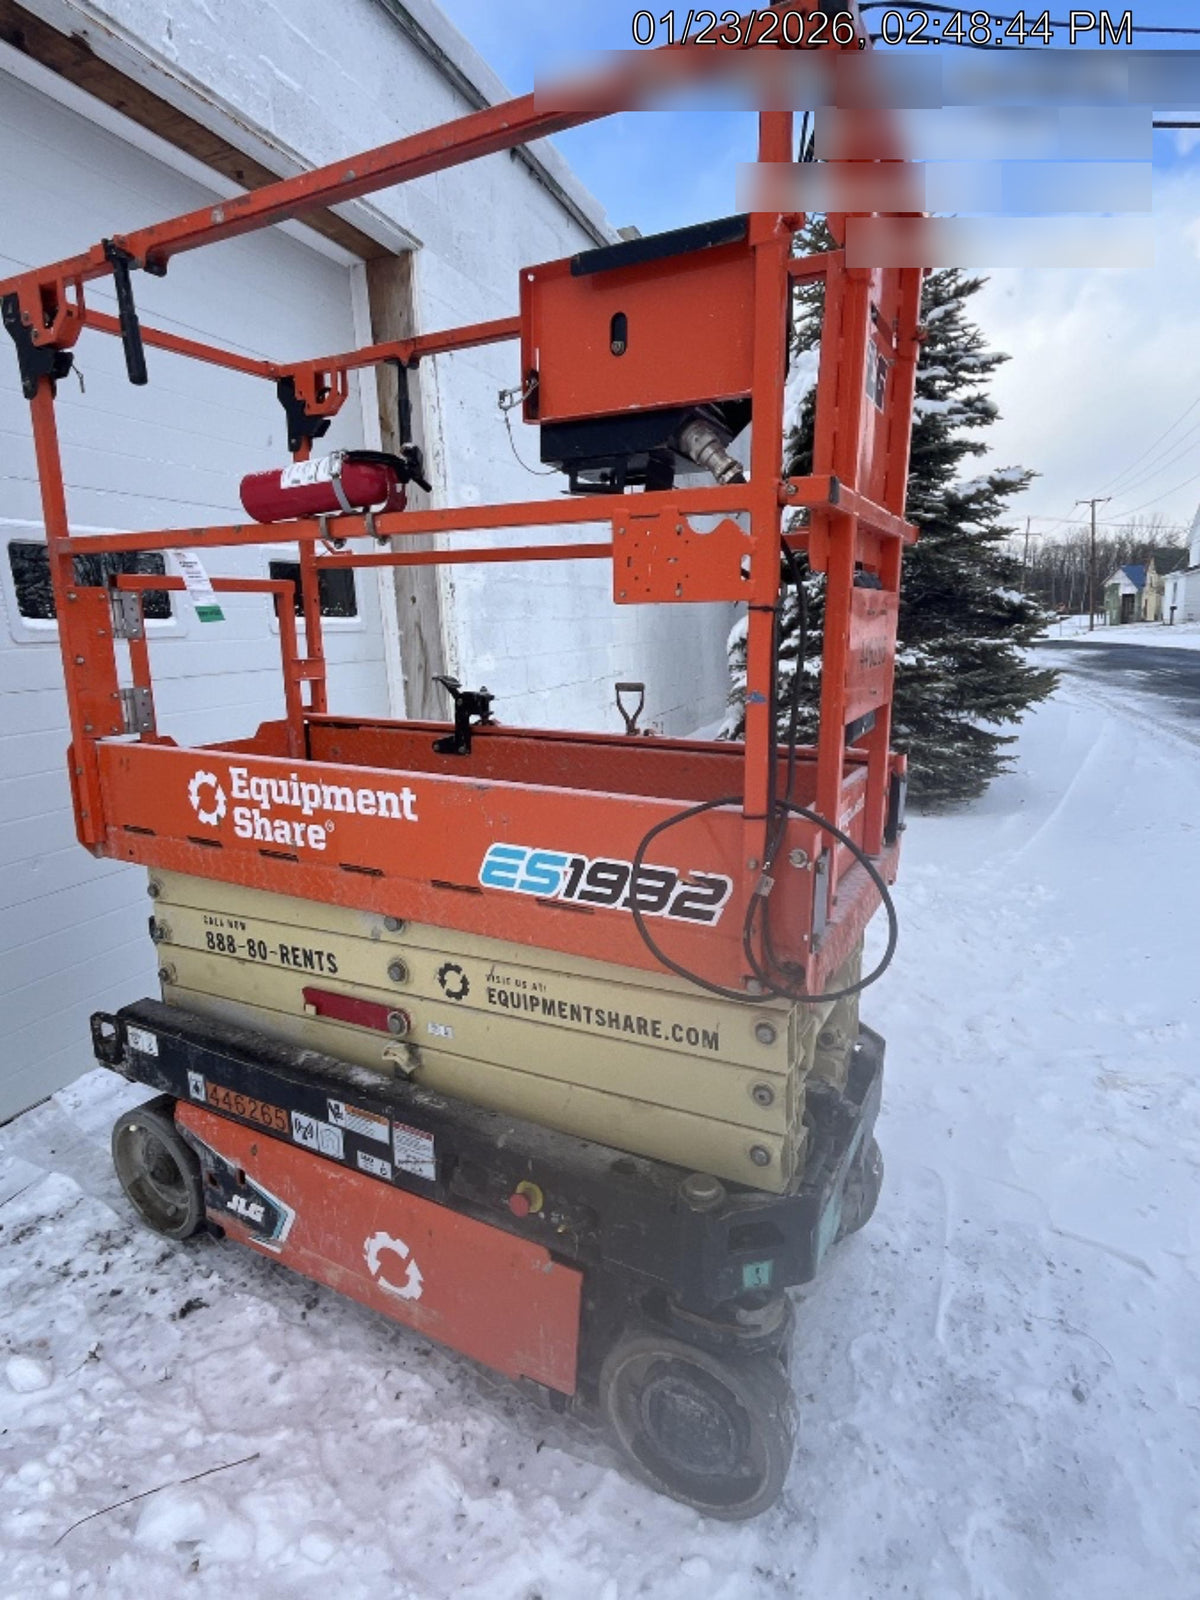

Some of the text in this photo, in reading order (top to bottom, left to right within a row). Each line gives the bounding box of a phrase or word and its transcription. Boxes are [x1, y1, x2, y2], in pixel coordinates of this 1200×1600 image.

[229, 766, 418, 821] Equipment
[205, 931, 338, 974] 888-80-RENTS
[515, 979, 527, 989] US
[487, 986, 720, 1051] EQUIPMENTSHARE.COM
[209, 1085, 287, 1131] 446265
[226, 1194, 265, 1222] JLG
